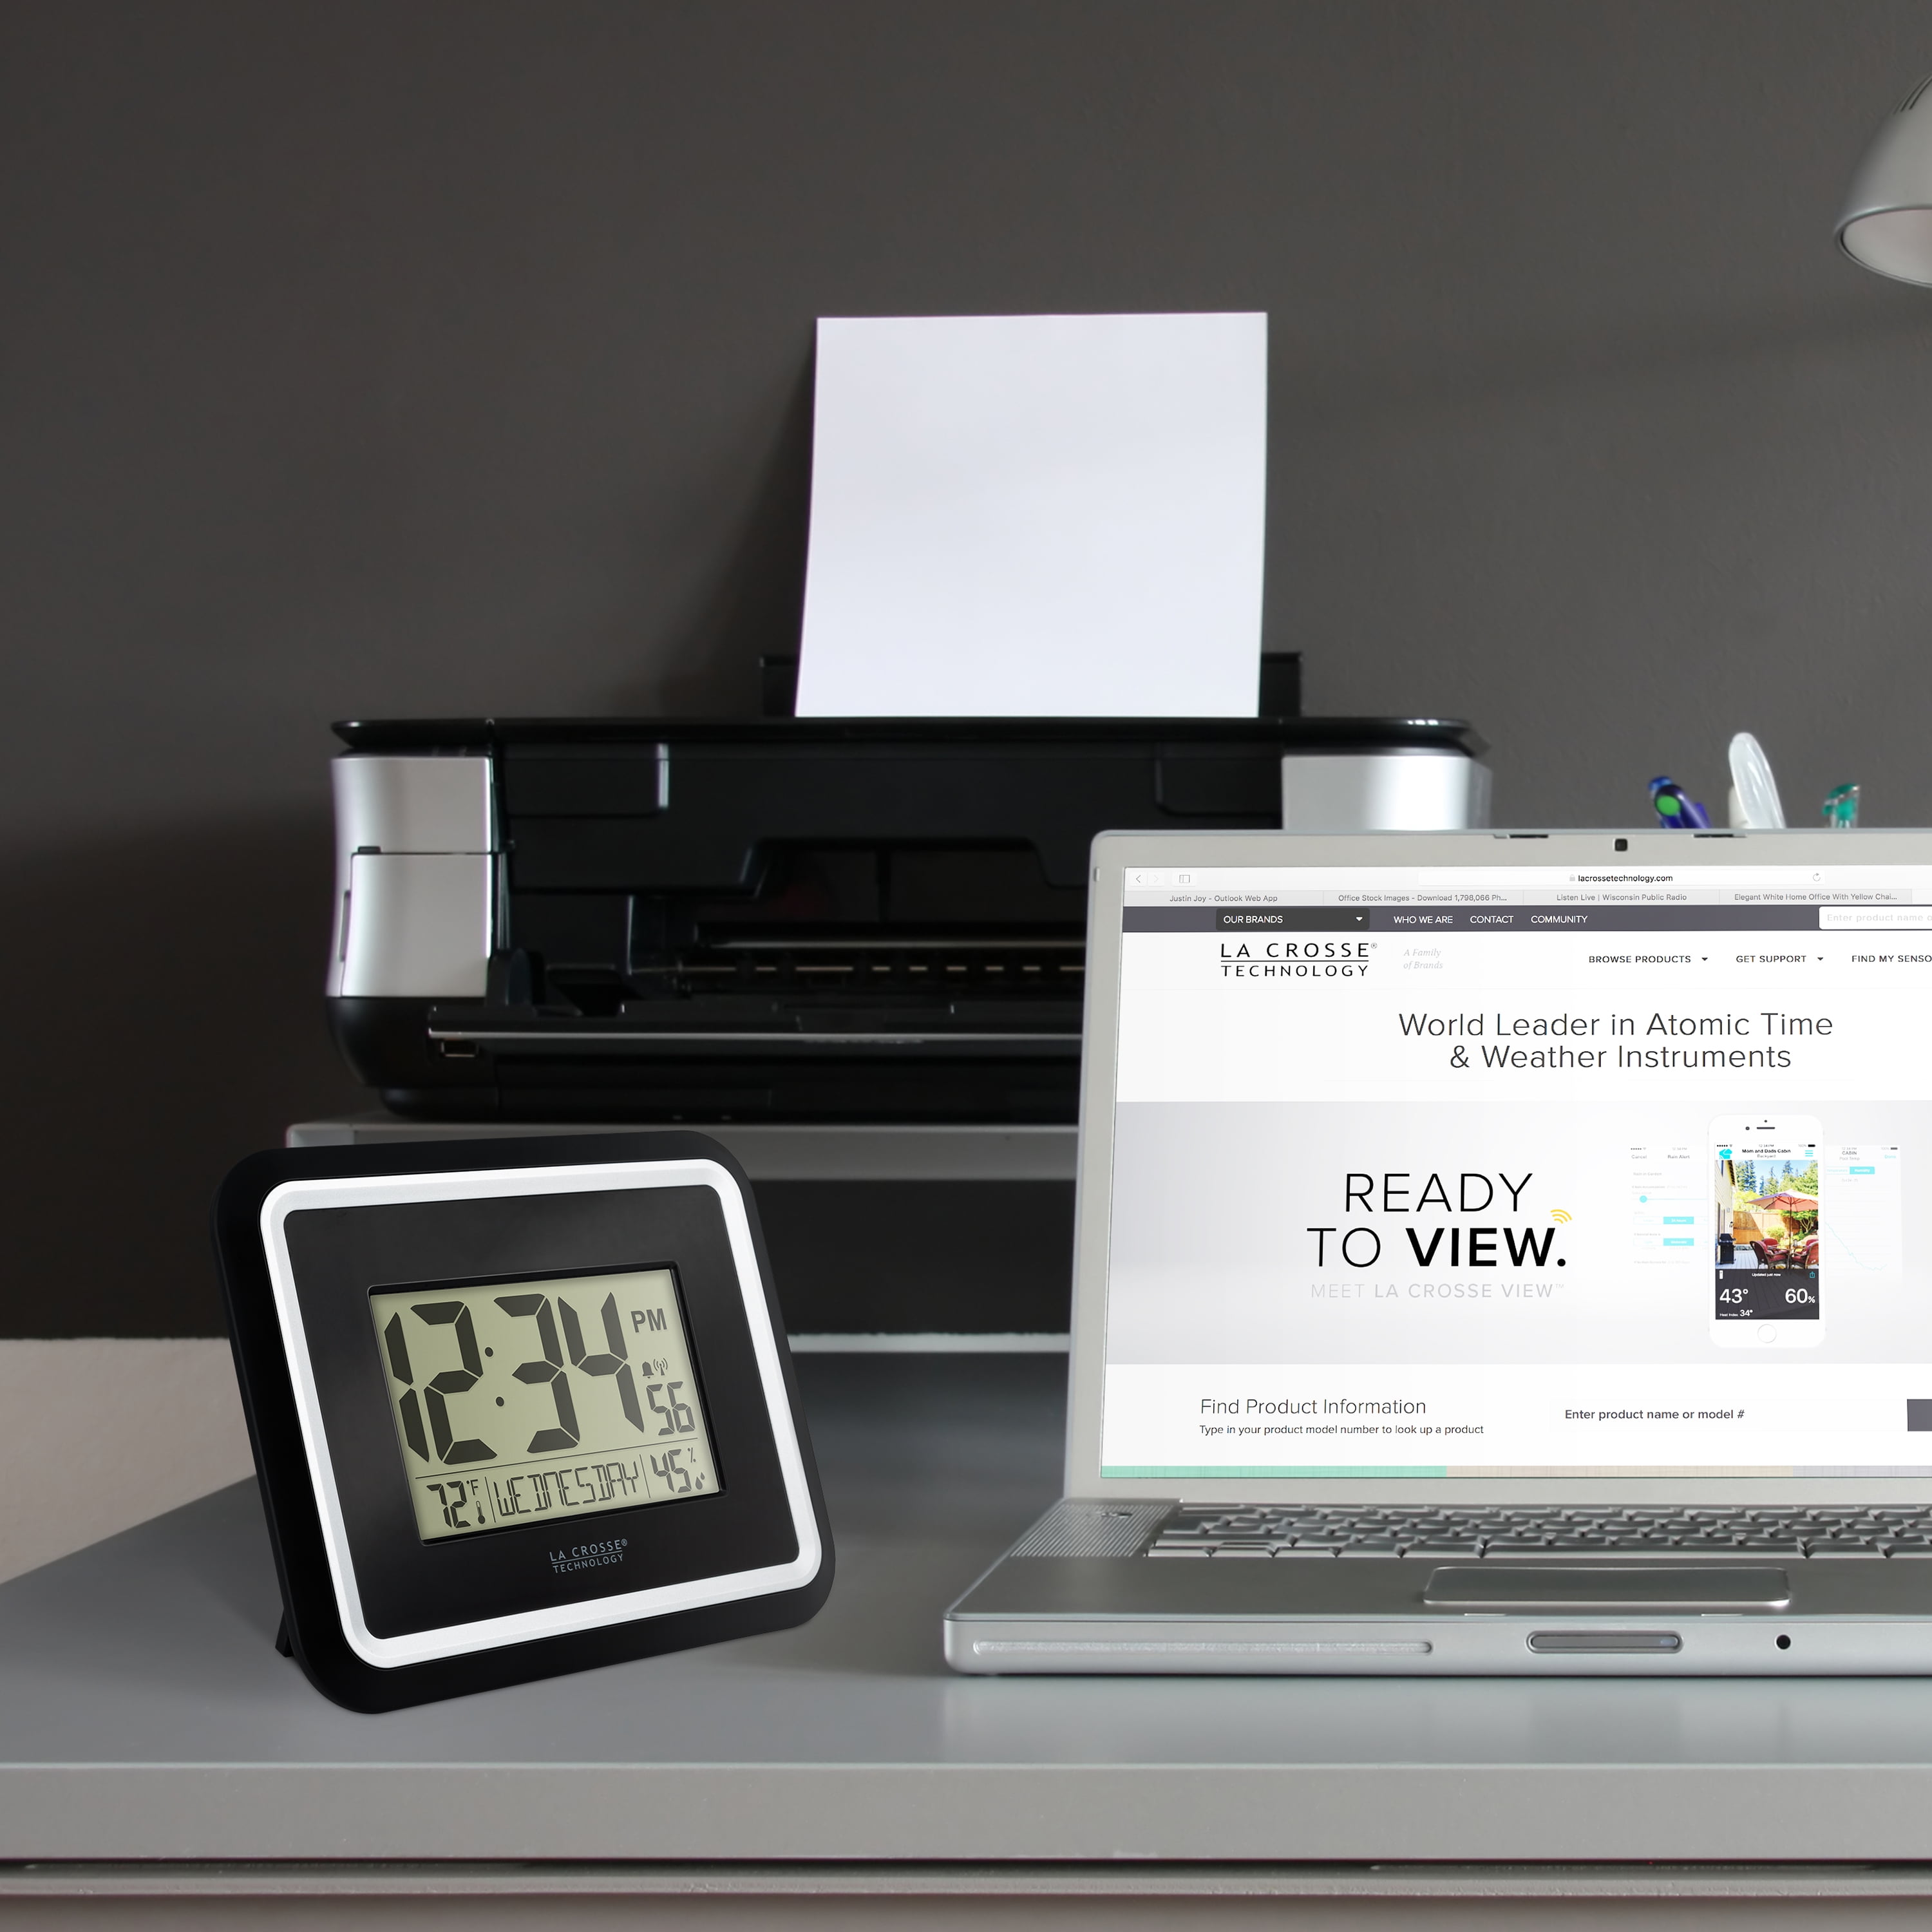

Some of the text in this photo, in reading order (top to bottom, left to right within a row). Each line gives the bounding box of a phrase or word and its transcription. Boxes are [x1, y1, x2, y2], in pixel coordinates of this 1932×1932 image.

[1578, 875, 1673, 884] lacrossetechnology.com
[1193, 895, 1207, 904] Joy
[1262, 895, 1278, 903] App
[1384, 895, 1410, 903] Images
[1454, 894, 1490, 902] 1,798,066
[1734, 893, 1761, 903] Elegant
[1223, 915, 1283, 924] OUR BRANDS
[1393, 915, 1454, 924] WHO WE ARE
[1470, 915, 1514, 923] CONTACT
[1531, 915, 1588, 923] COMMUNITY
[1856, 913, 1893, 923] product
[1220, 943, 1251, 958] LA
[1412, 947, 1442, 958] Family
[1589, 955, 1691, 963] BROWSE PRODUCTS
[1220, 965, 1368, 977] TECHNOLOGY
[1403, 960, 1444, 971] of Brands
[1398, 1012, 1833, 1036] World Leader in Atomic Time
[1450, 1045, 1791, 1068] & Weather Instruments
[1345, 1173, 1533, 1213] READY
[1306, 1227, 1566, 1268] TO VIEW.
[1311, 1283, 1365, 1298] MEET
[1375, 1283, 1399, 1298] LA
[1408, 1283, 1492, 1298] CROSSE
[1785, 1288, 1815, 1304] 60%
[630, 1308, 667, 1333] PM
[384, 1291, 645, 1465] 12:34
[646, 1381, 696, 1436] 56
[1201, 1398, 1426, 1414] Find Product Information
[1565, 1409, 1745, 1421] Enter product name or model #
[1199, 1425, 1224, 1436] Type
[1227, 1425, 1236, 1434] in
[1238, 1426, 1262, 1436] your
[1264, 1425, 1303, 1436] product
[1305, 1425, 1338, 1434] model
[1340, 1425, 1379, 1434] number
[1381, 1425, 1392, 1434] to
[1395, 1425, 1417, 1434] look
[1419, 1426, 1433, 1436] up
[1444, 1425, 1484, 1436] product
[493, 1461, 639, 1517] WEDNESDAY
[549, 1549, 566, 1562] LA
[553, 1553, 623, 1573] TECHNOLOGY
